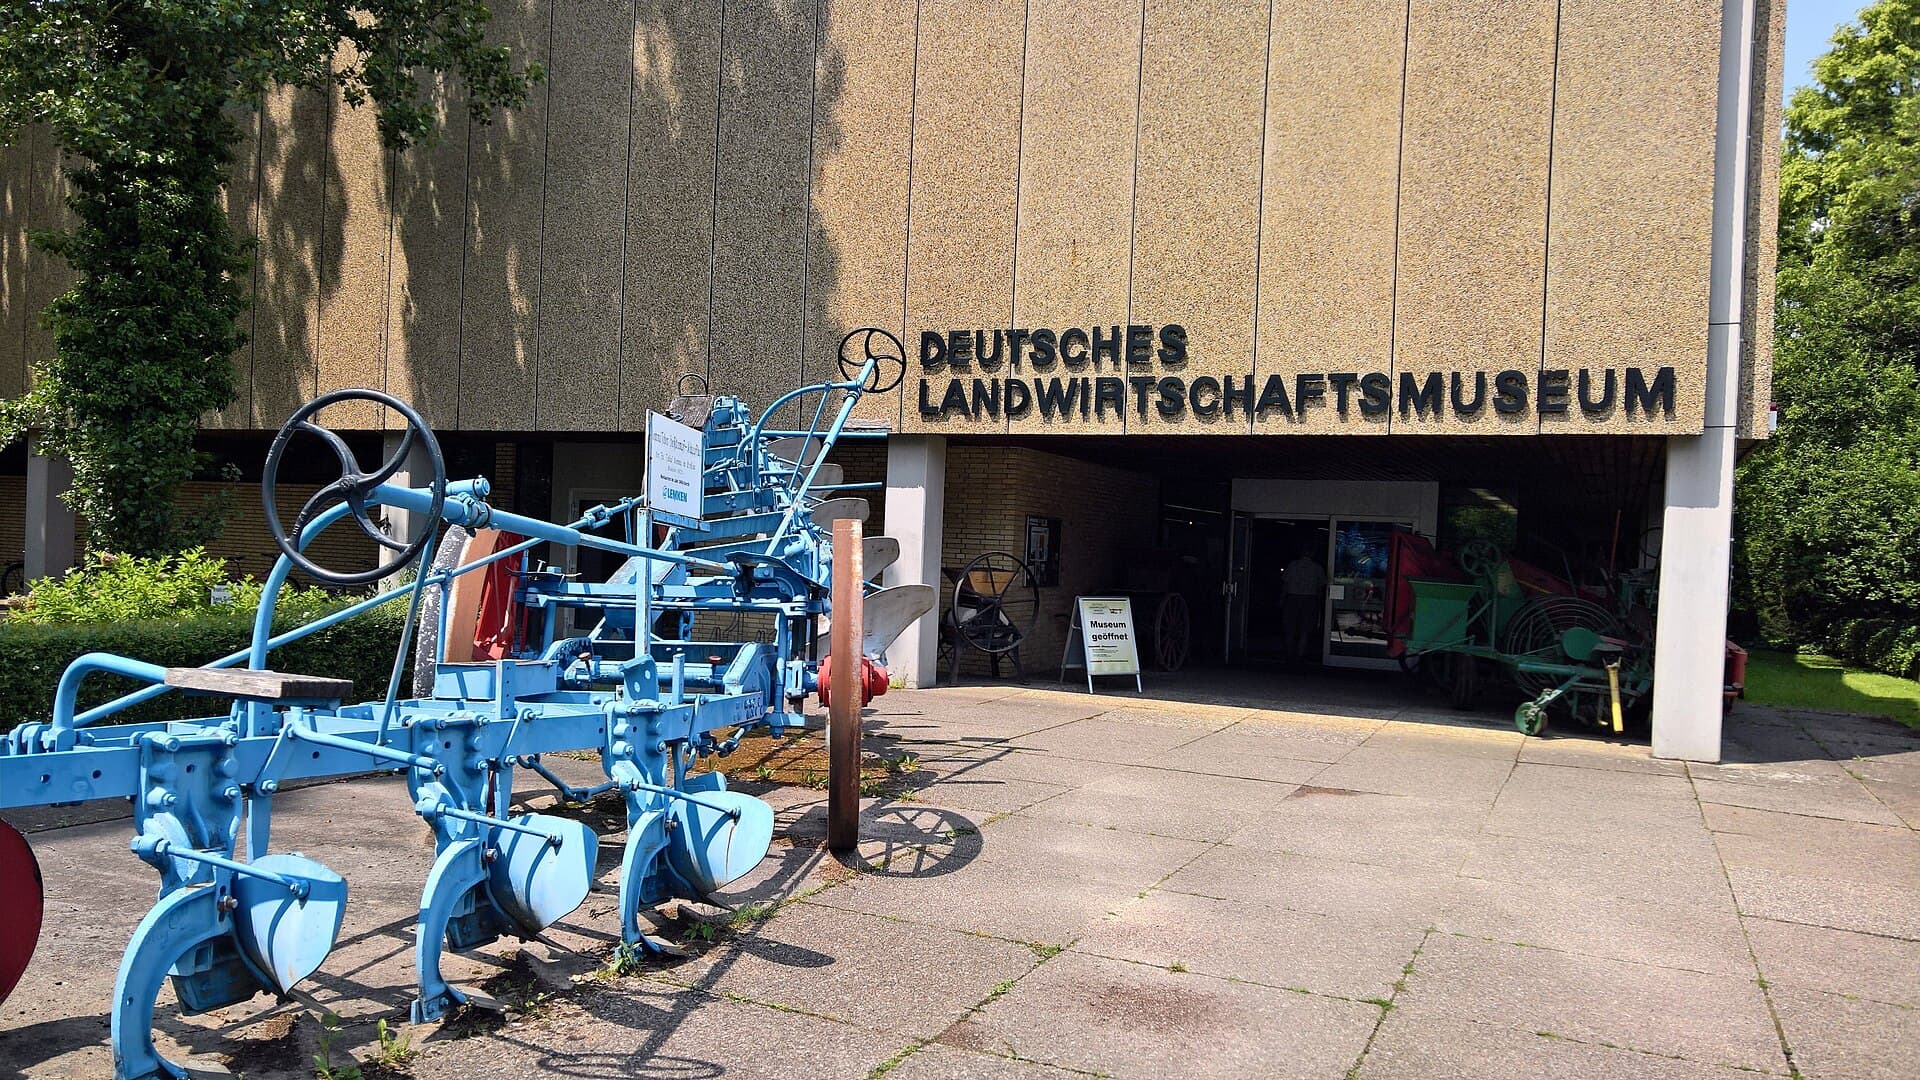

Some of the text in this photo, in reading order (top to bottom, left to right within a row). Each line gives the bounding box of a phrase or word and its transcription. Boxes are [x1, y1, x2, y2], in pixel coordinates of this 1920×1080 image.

[920, 324, 1188, 367] DEUTSCHES
[919, 367, 1675, 414] LANDWIRTSCHAFTSMUSEUM
[1090, 620, 1126, 628] Museum
[1092, 632, 1129, 641] geöffnet
